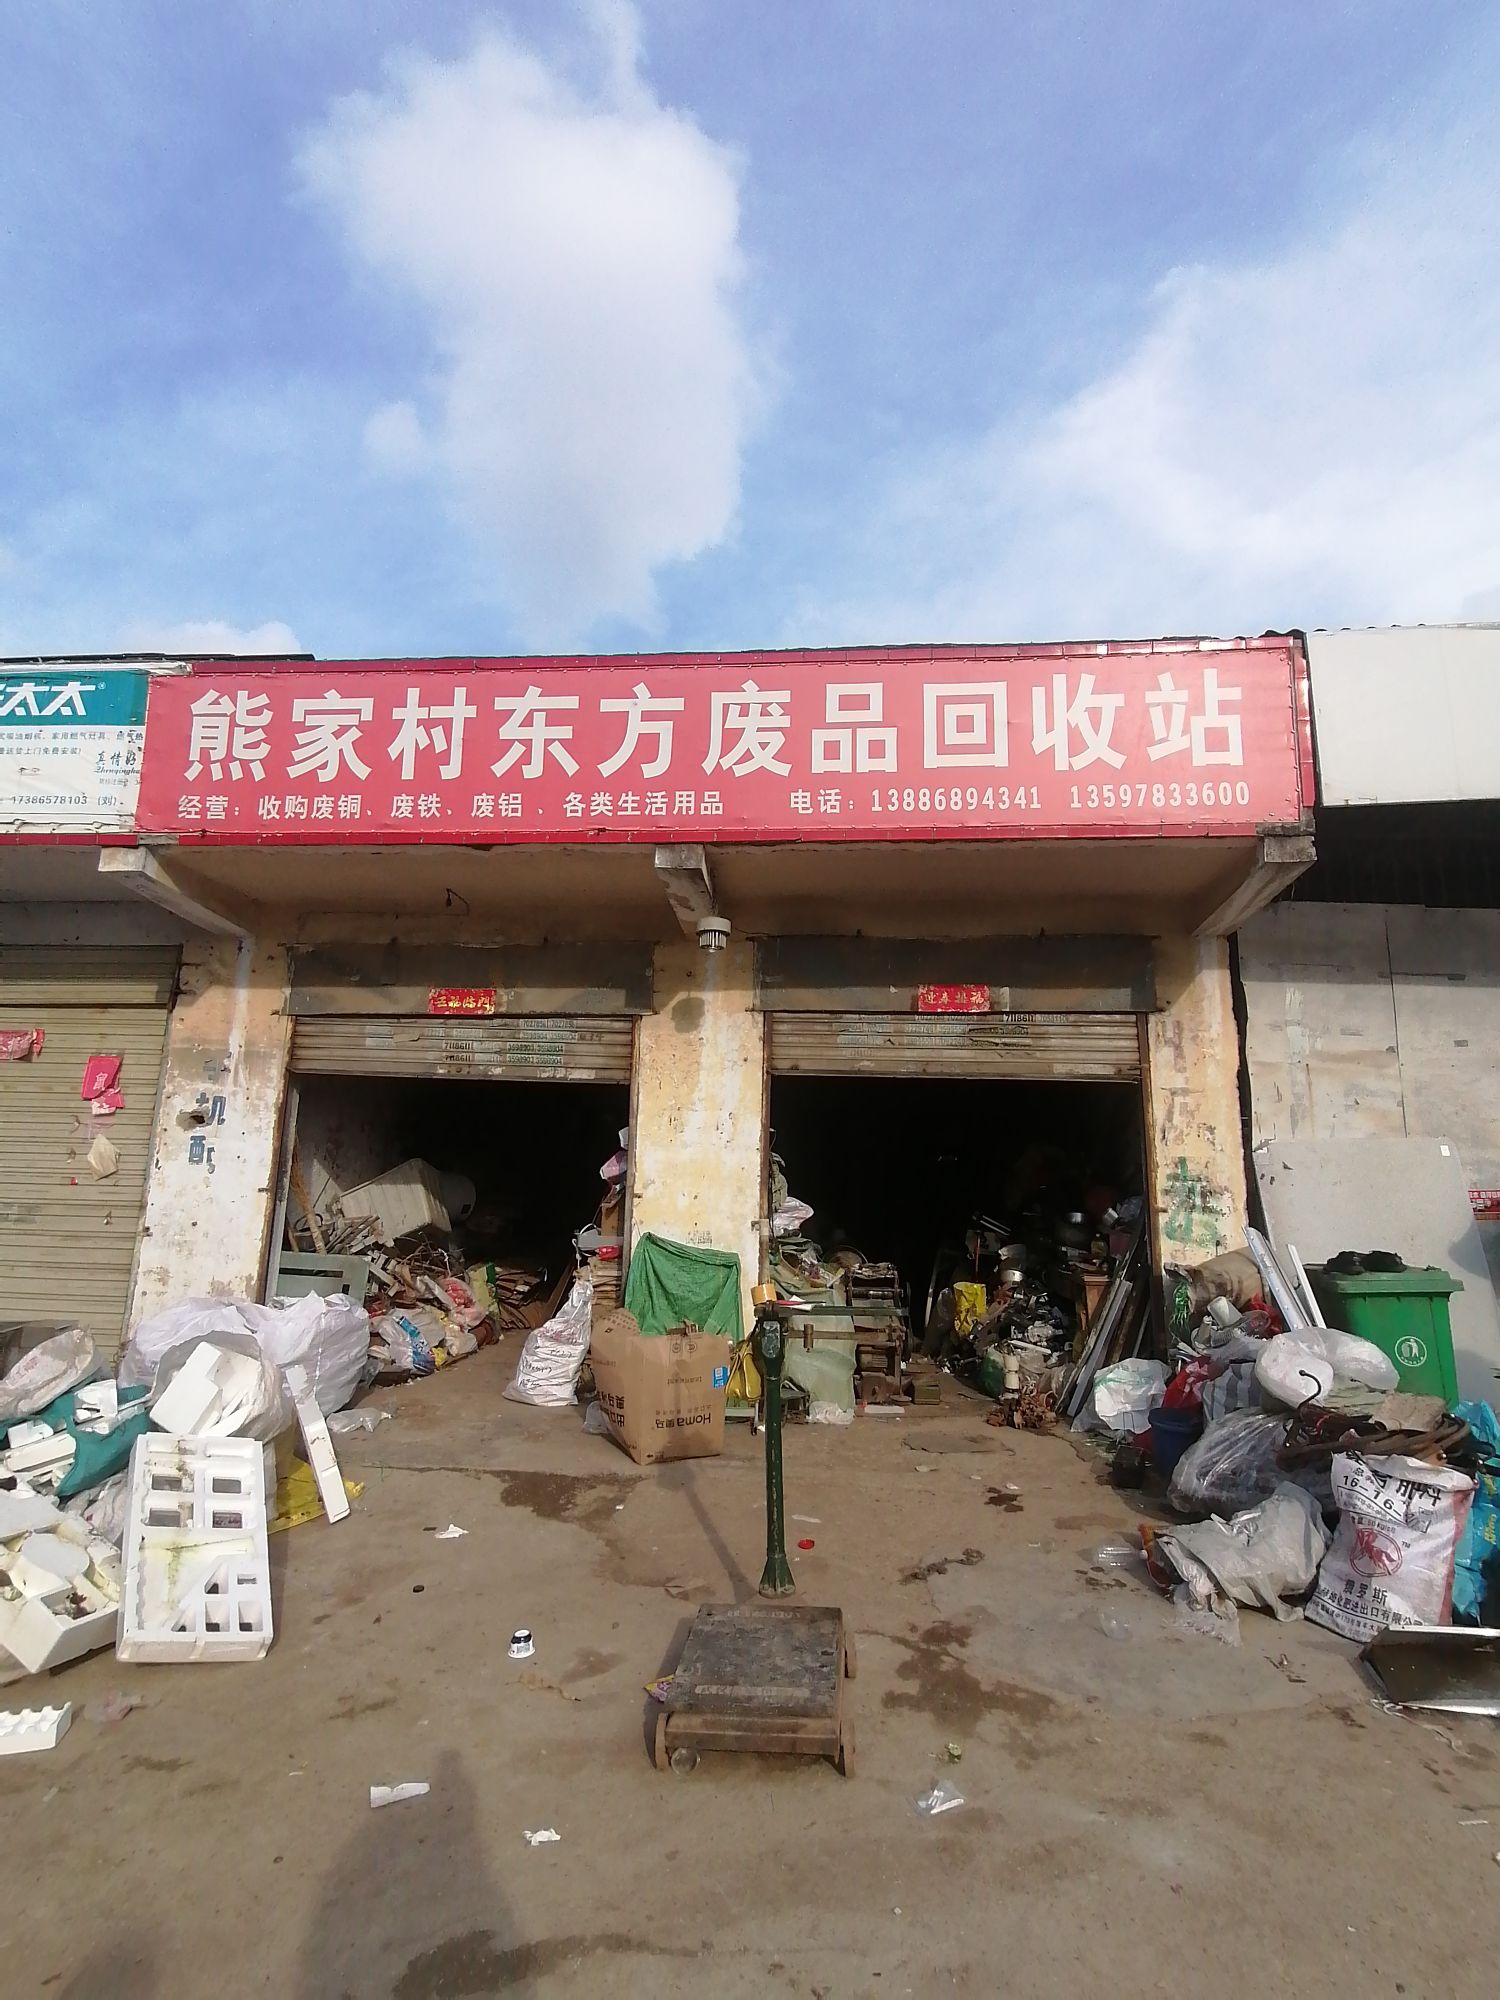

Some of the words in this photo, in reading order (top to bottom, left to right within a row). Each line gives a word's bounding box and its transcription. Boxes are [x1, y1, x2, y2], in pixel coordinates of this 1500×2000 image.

[0, 682, 96, 716] 太太
[184, 668, 1244, 783] 熊家村东方废品回收站
[12, 795, 88, 805] 17386578103
[1070, 781, 1250, 809] 13597833600
